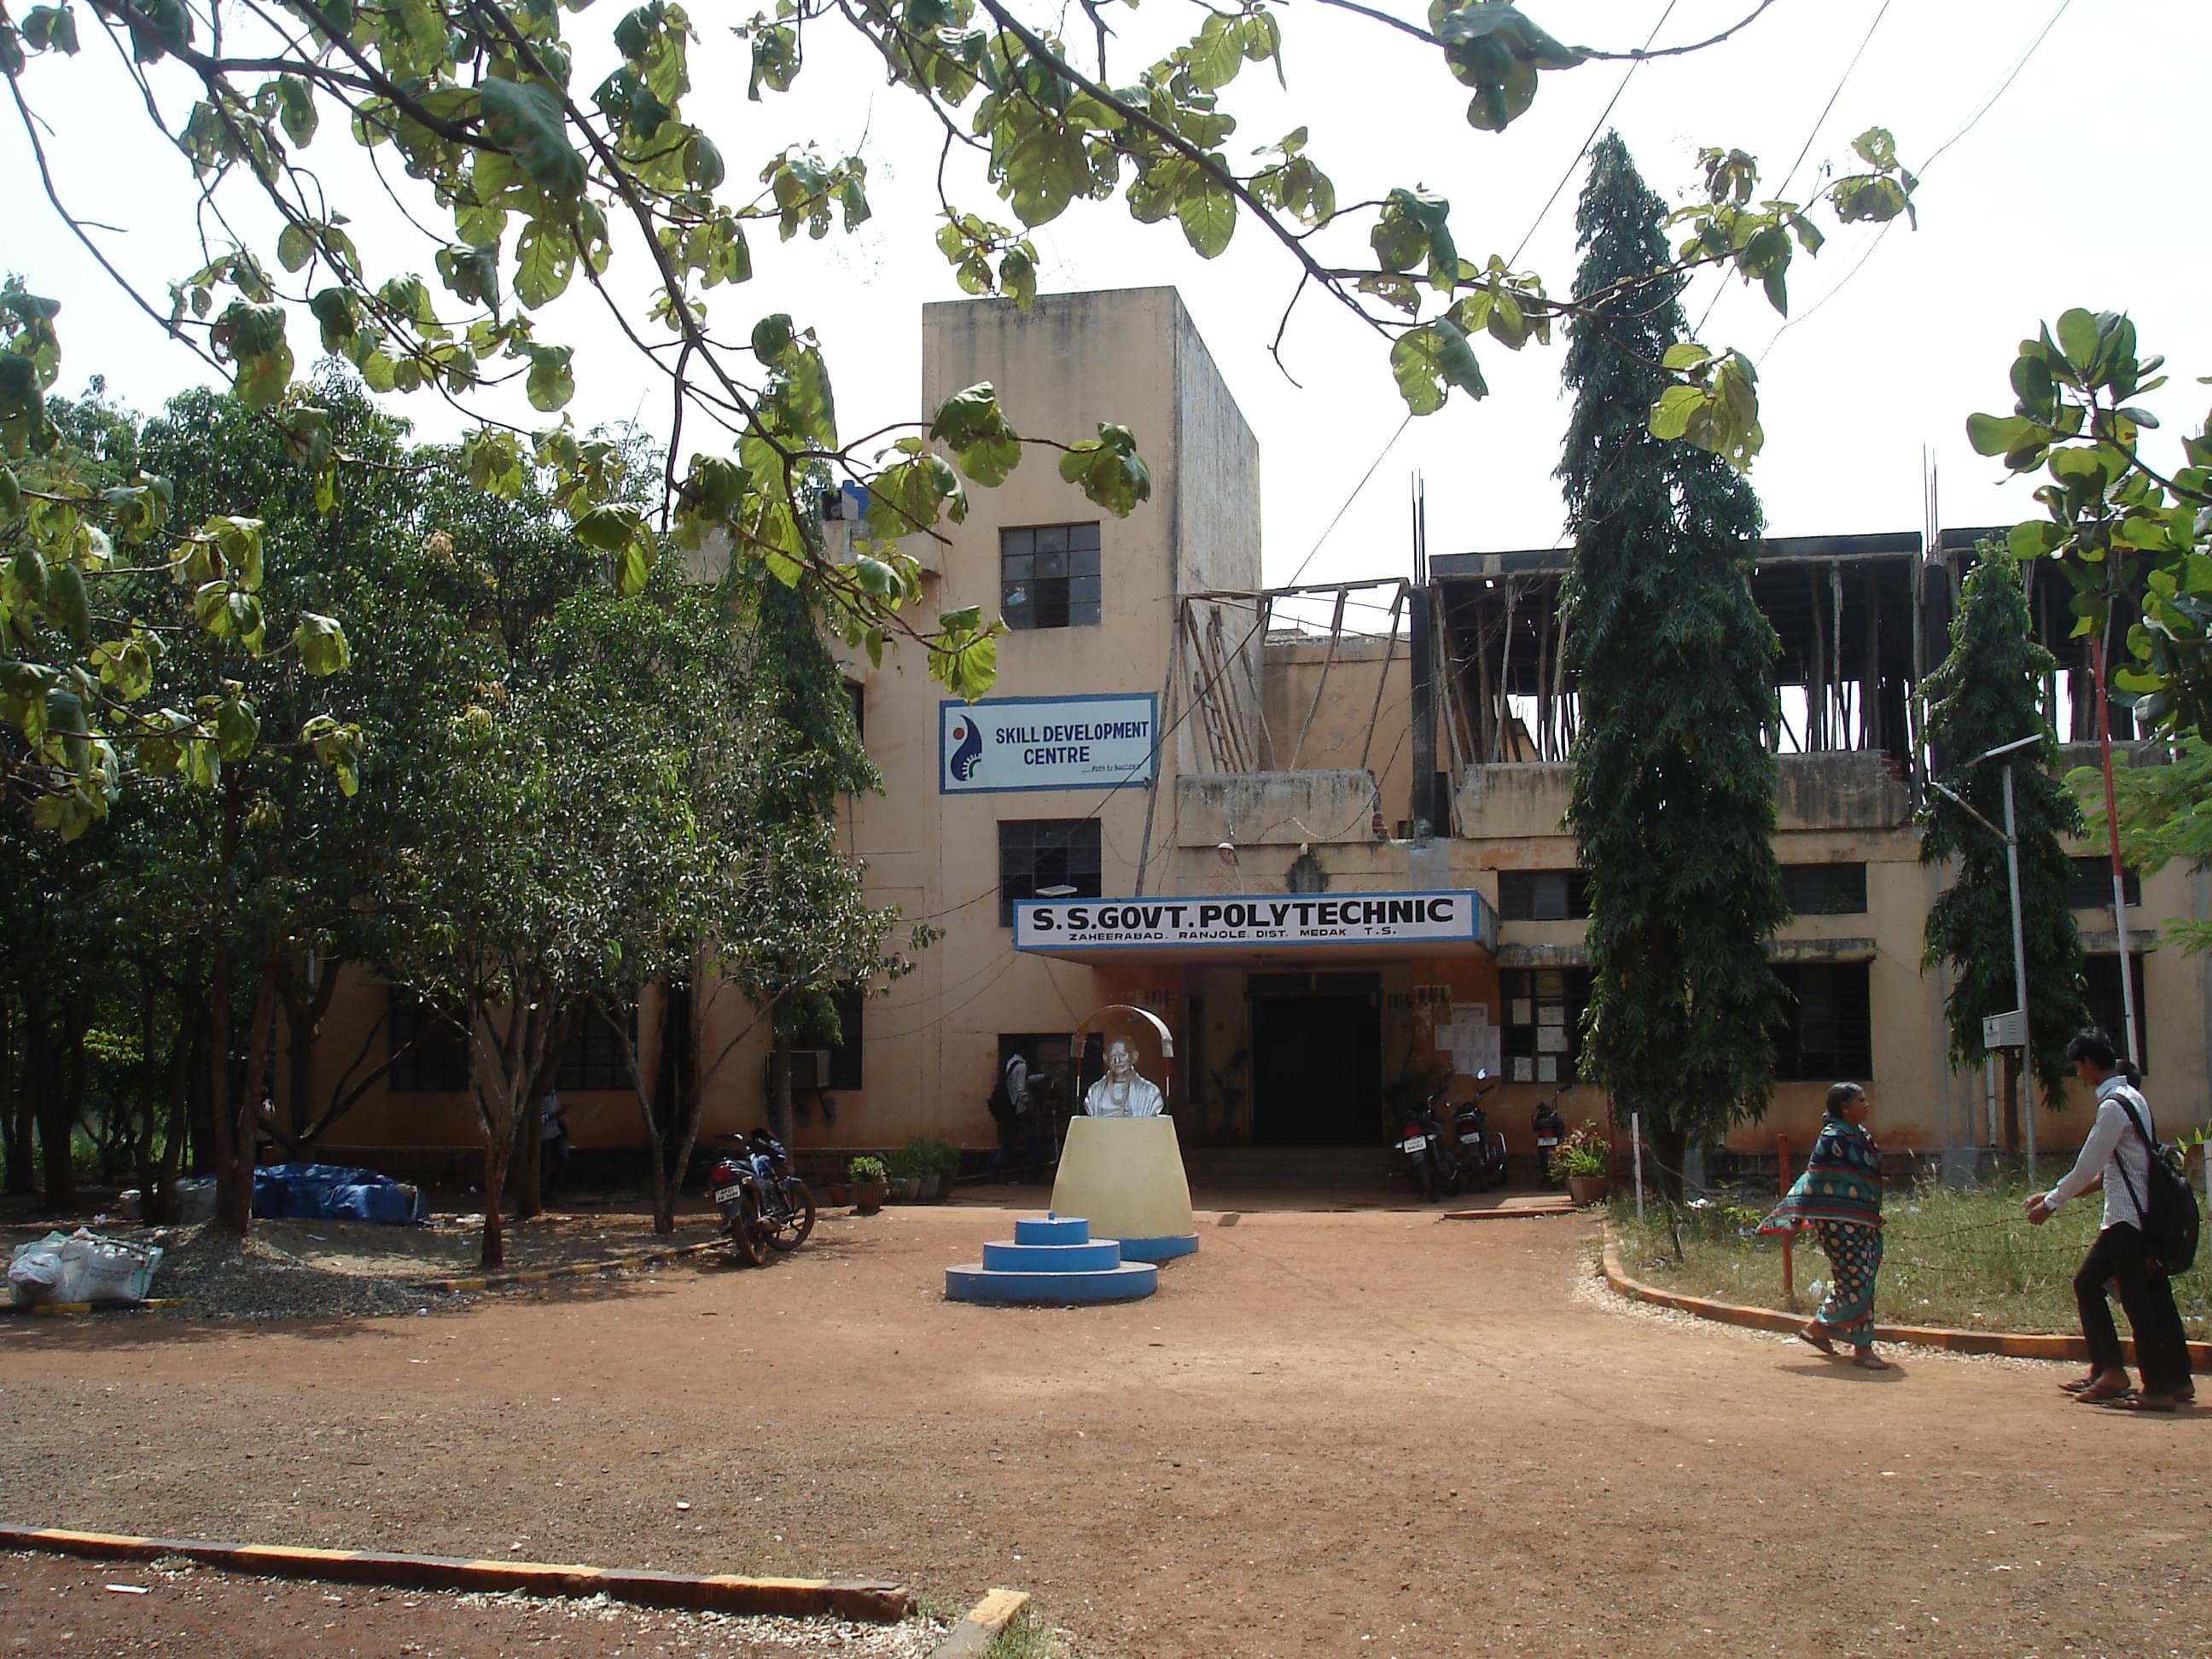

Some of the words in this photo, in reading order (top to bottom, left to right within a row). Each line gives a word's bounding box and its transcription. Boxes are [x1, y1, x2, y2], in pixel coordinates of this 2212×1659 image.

[996, 727, 1039, 744] SKILL
[1043, 720, 1149, 742] DEVELOPMENT
[1024, 746, 1090, 765] CENTRE
[1365, 927, 1397, 935] T.S.
